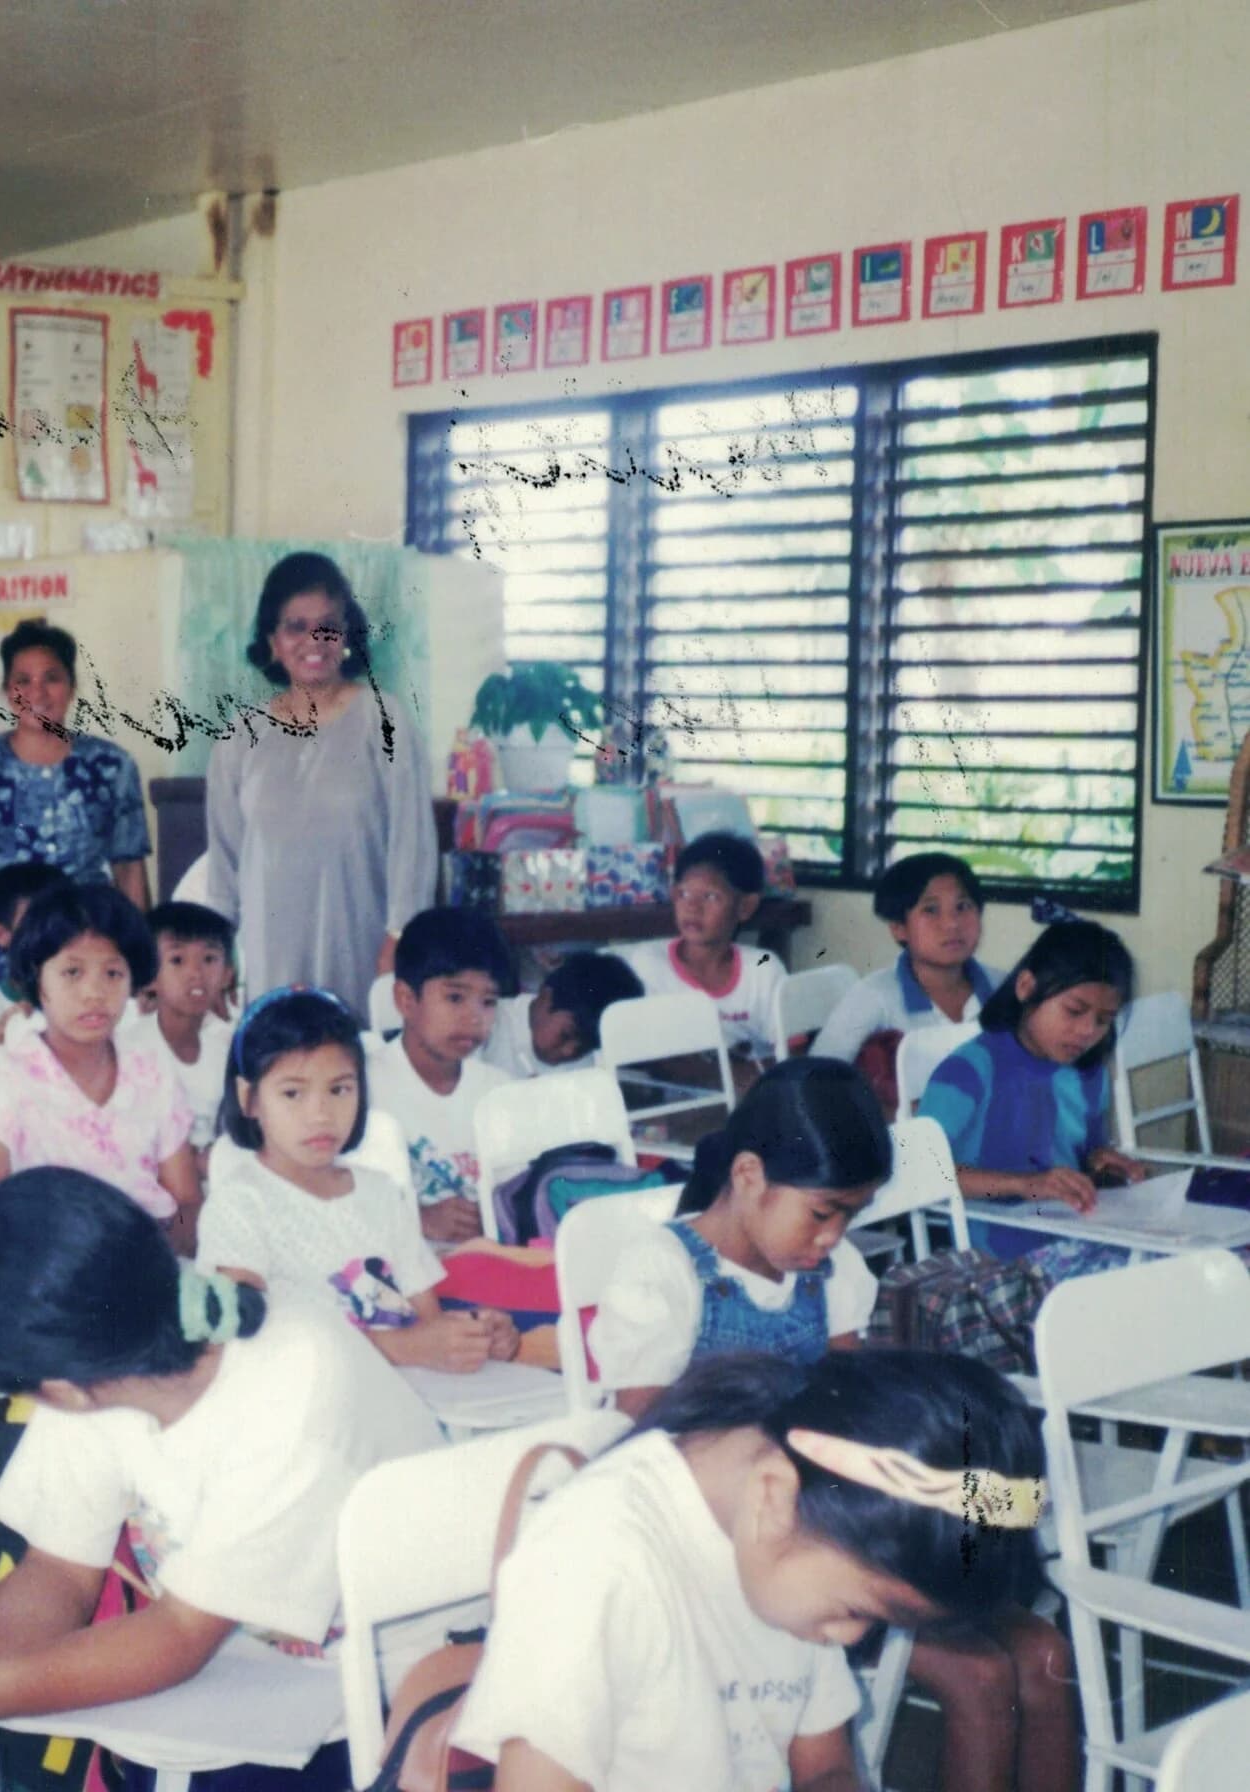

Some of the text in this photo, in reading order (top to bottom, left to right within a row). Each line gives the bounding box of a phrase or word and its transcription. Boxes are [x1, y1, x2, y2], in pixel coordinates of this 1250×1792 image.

[1091, 223, 1101, 251] L
[1175, 212, 1192, 239] M
[1011, 235, 1023, 262] K
[1169, 552, 1233, 578] NUEVA
